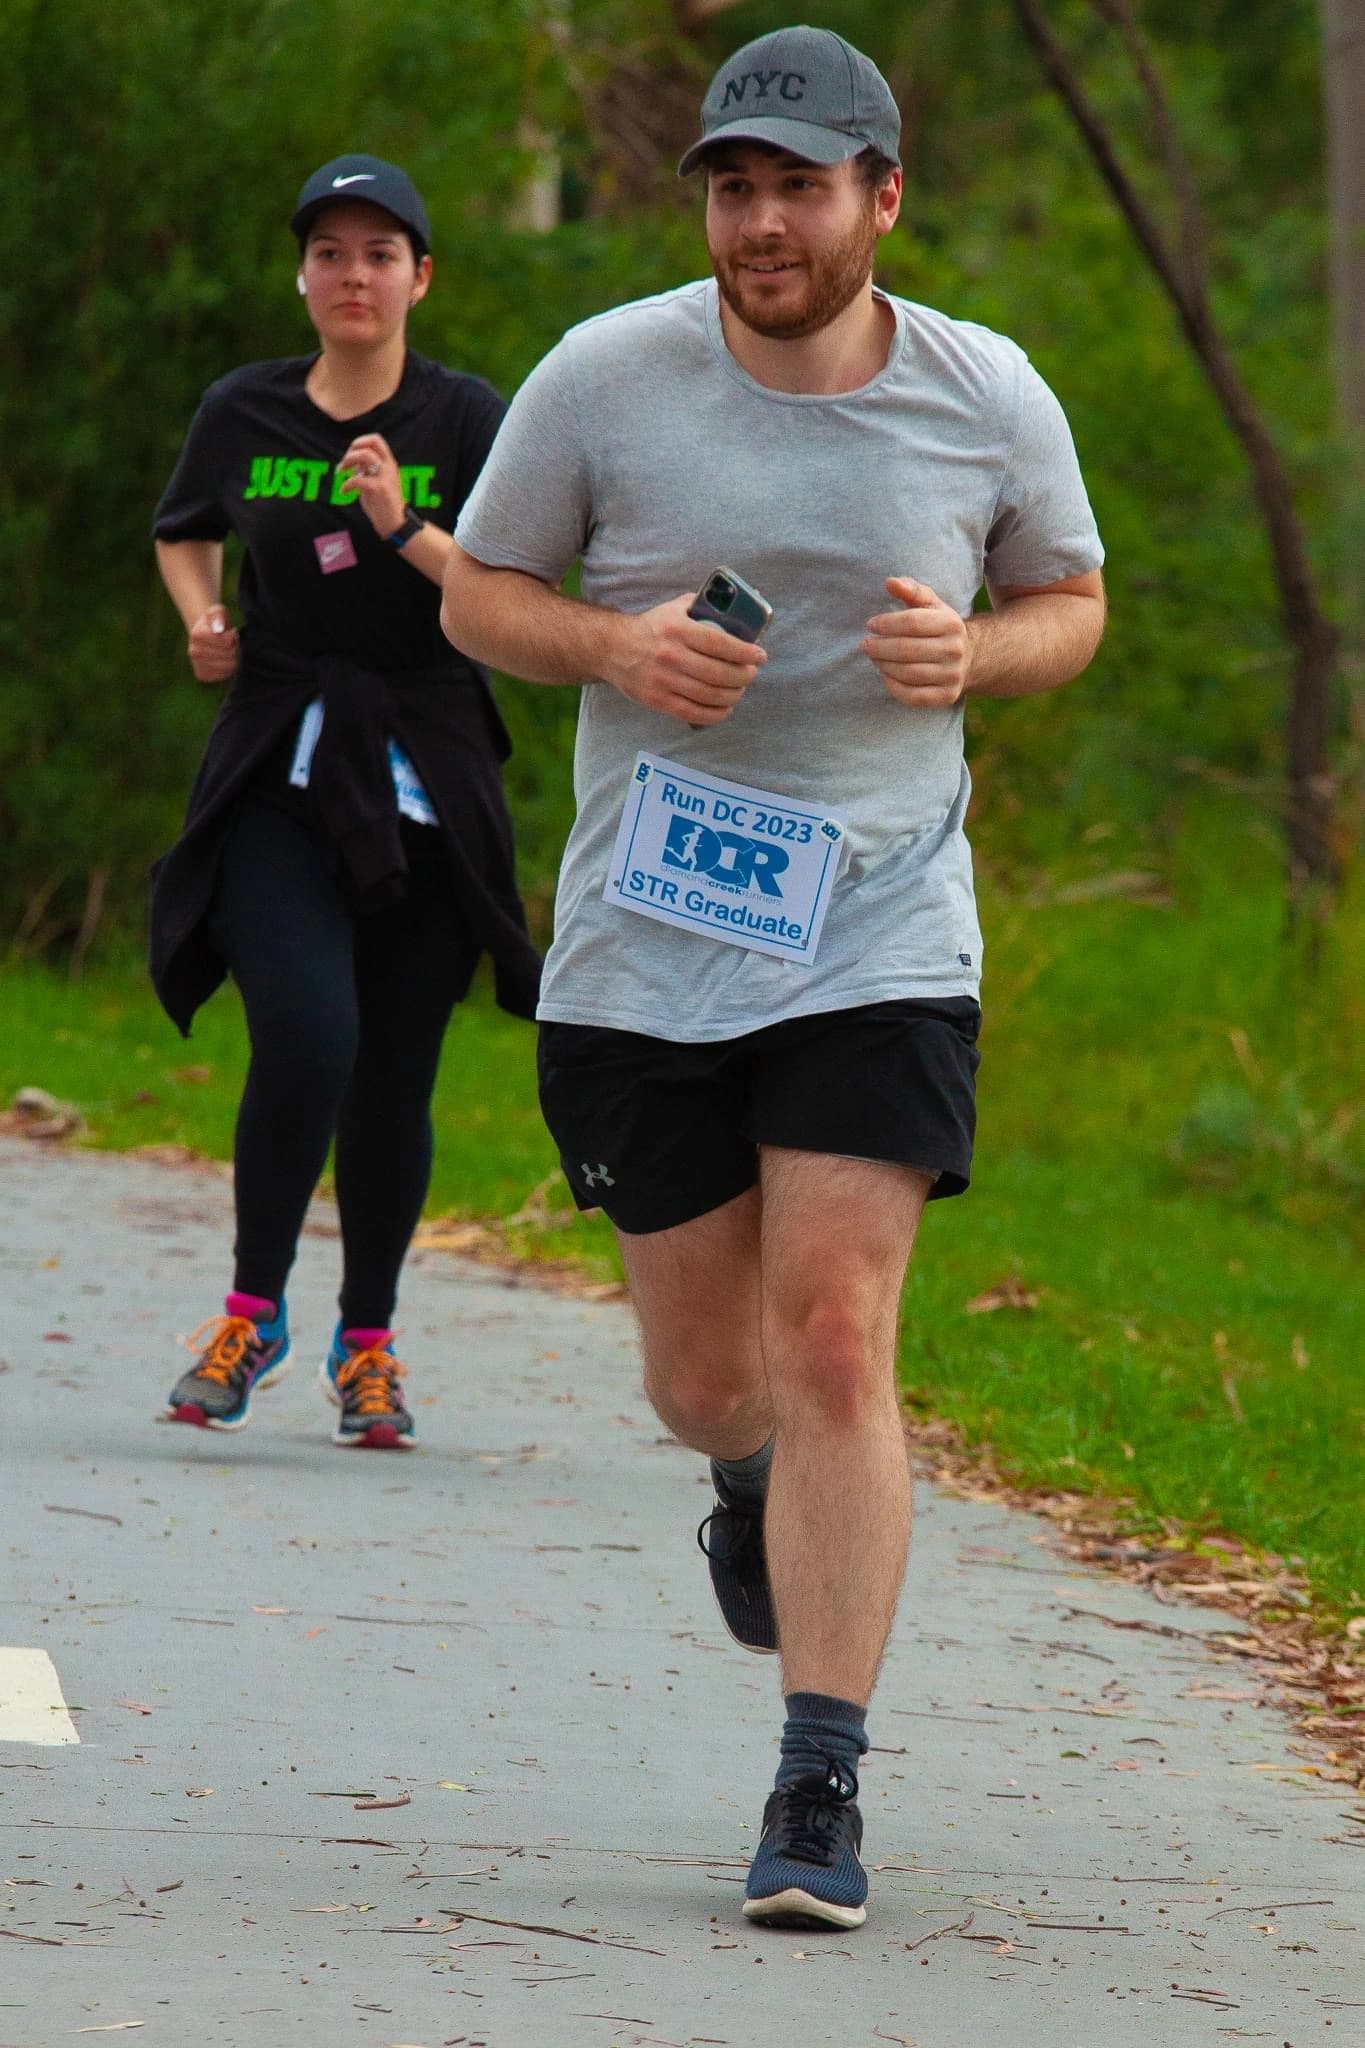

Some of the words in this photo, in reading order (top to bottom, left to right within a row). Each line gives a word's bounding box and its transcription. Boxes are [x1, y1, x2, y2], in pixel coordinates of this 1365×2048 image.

[720, 70, 807, 110] NYC
[243, 455, 329, 502] JUST
[661, 782, 706, 815] Run
[712, 800, 748, 828] DC
[752, 811, 813, 844] 2023
[661, 813, 790, 898] DCR
[629, 869, 679, 905] STR
[684, 889, 803, 940] Graduate
